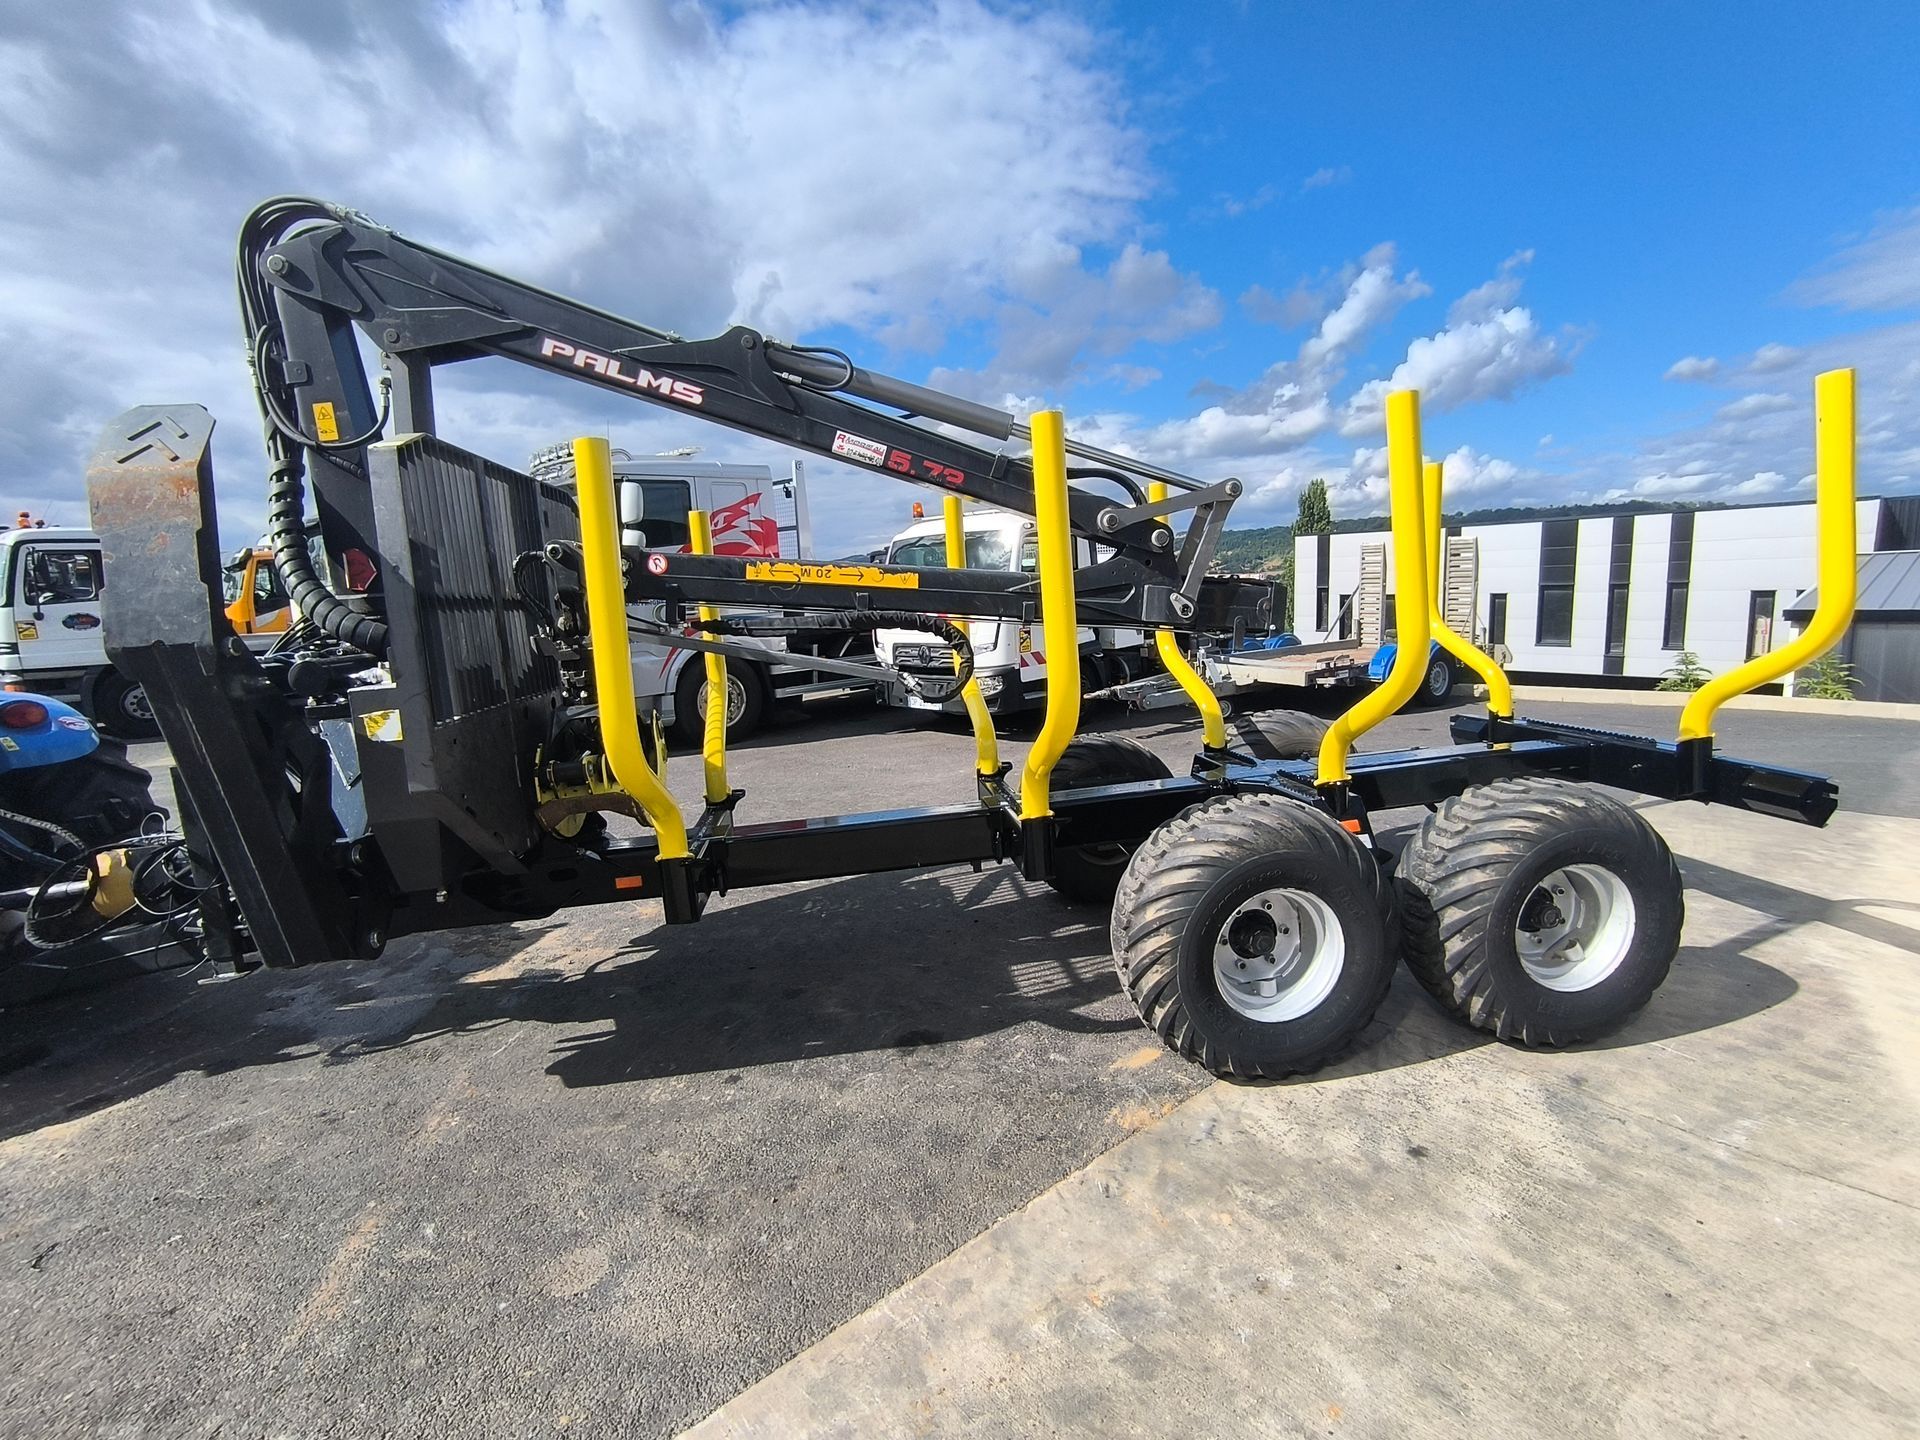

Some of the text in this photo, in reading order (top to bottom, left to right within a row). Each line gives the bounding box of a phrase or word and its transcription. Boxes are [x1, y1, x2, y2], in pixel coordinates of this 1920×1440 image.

[541, 337, 705, 405] PALMS
[800, 567, 831, 579] 20 M
